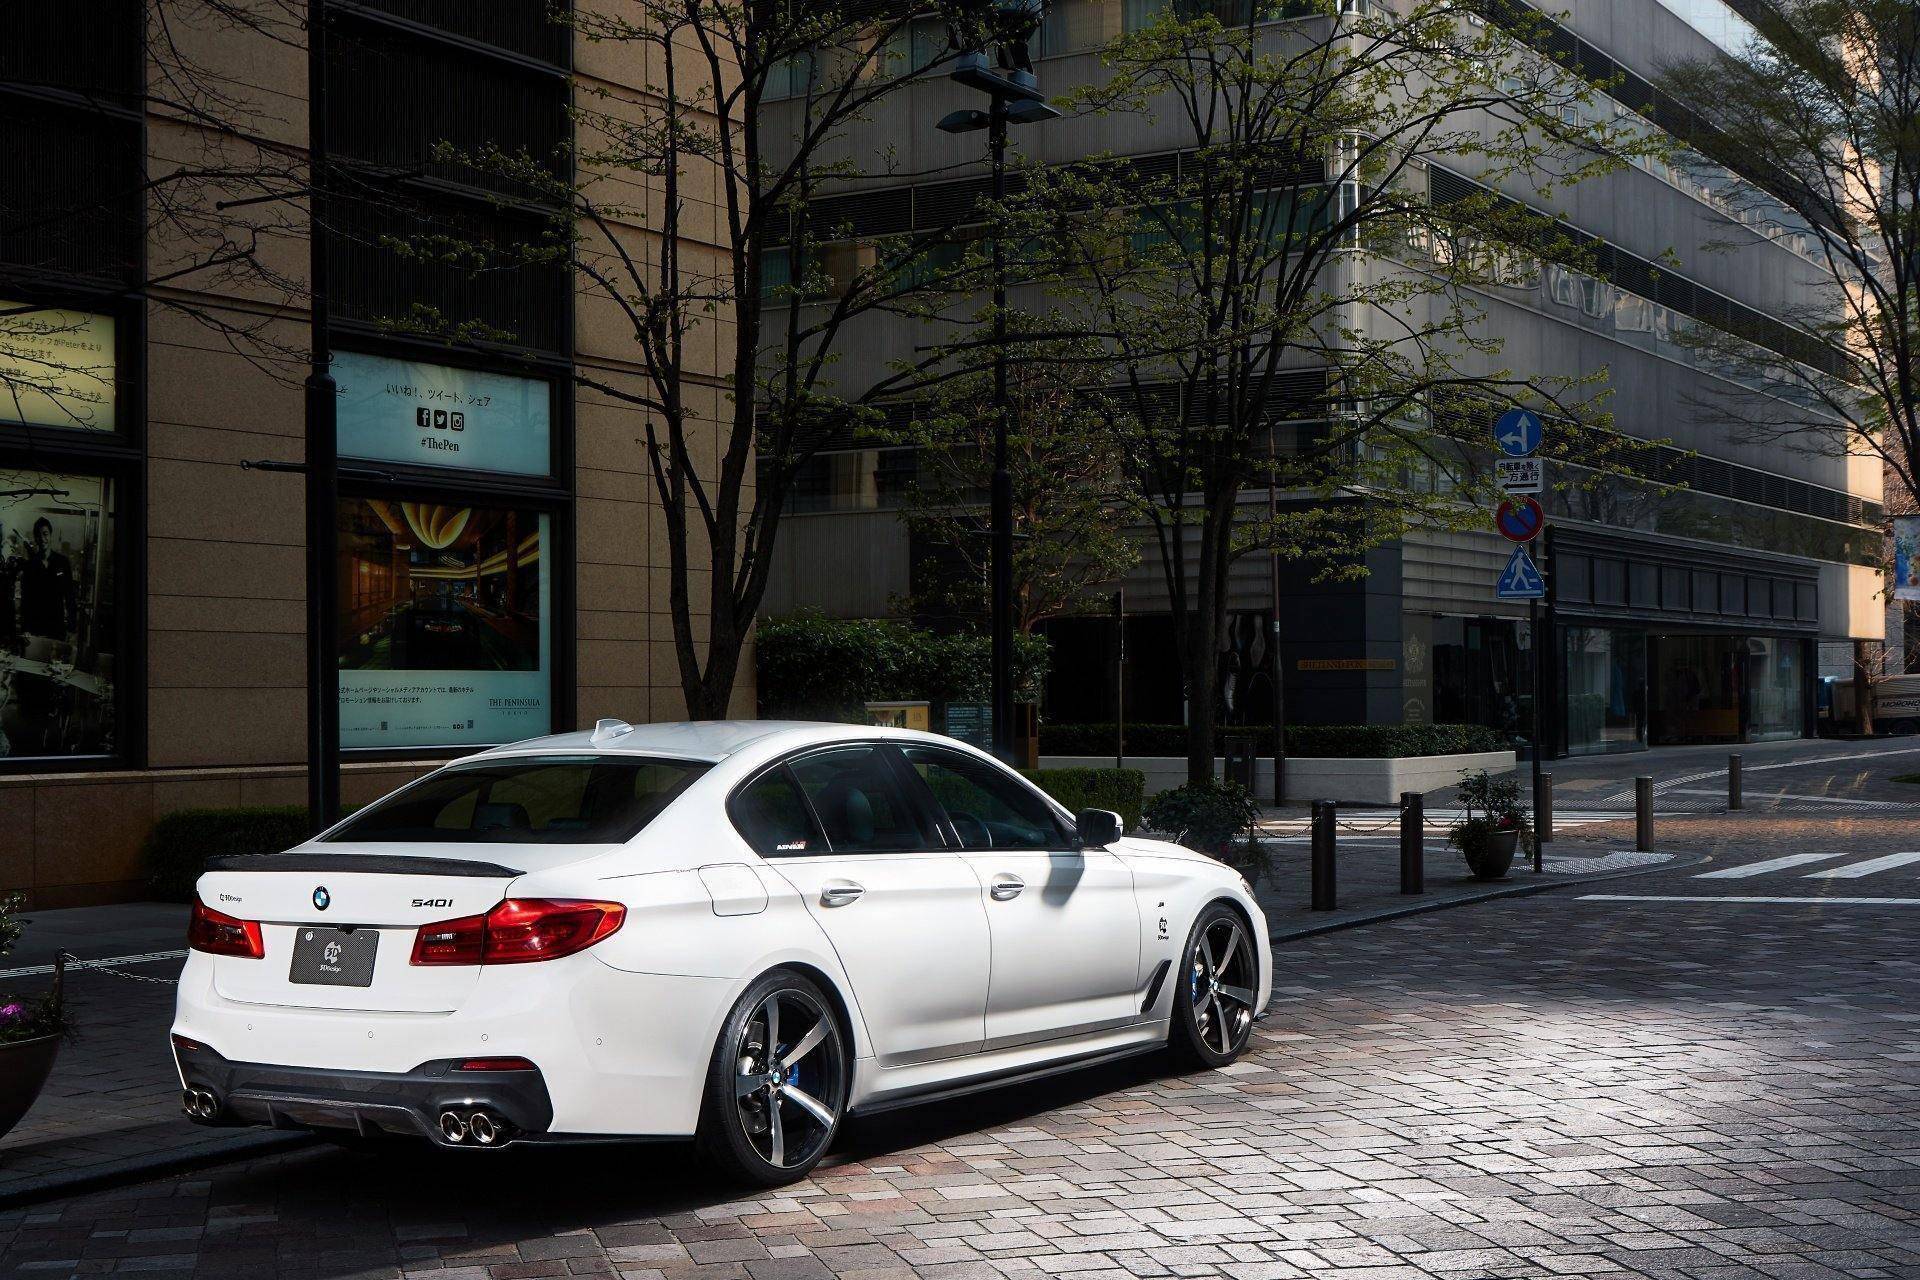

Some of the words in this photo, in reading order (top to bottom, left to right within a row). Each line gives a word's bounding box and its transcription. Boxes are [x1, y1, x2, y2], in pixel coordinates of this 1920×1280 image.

[421, 437, 460, 452] #ThePen
[1500, 472, 1540, 482] 一方通行
[488, 698, 502, 707] THE
[504, 698, 541, 707] PENINSULA
